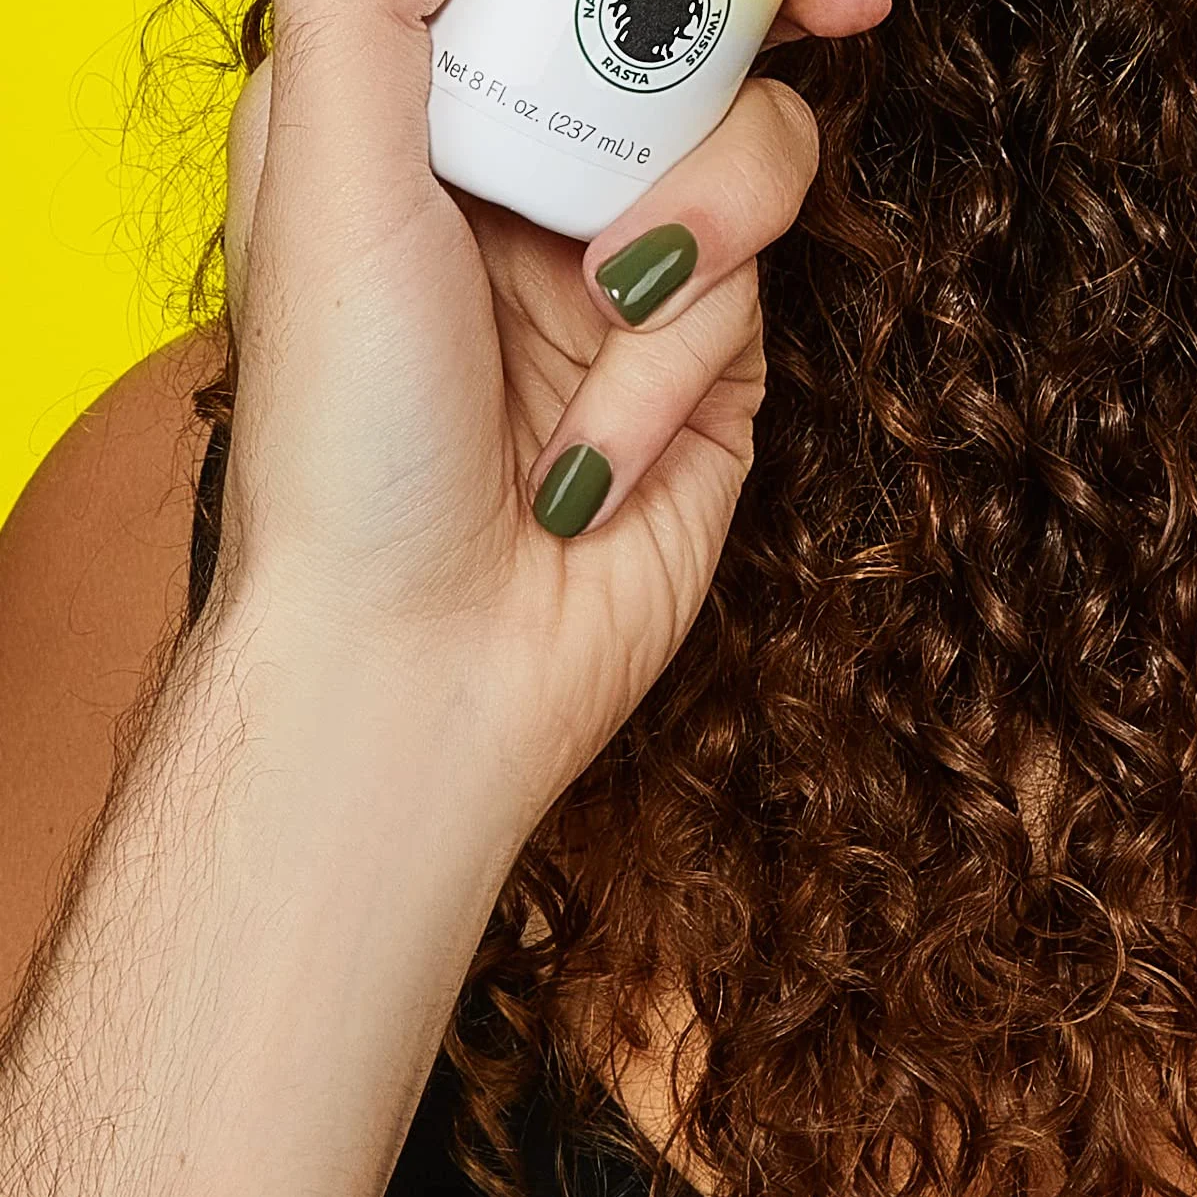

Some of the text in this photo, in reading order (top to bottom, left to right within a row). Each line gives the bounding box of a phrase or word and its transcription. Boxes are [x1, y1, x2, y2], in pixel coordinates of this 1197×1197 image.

[686, 8, 723, 66] TWISTS
[601, 56, 649, 85] RASTA
[437, 50, 468, 83] Net
[468, 71, 485, 91] 8
[486, 80, 507, 106] Fl.
[514, 99, 540, 122] oz.
[548, 111, 597, 143] (237
[597, 134, 634, 161] mL)
